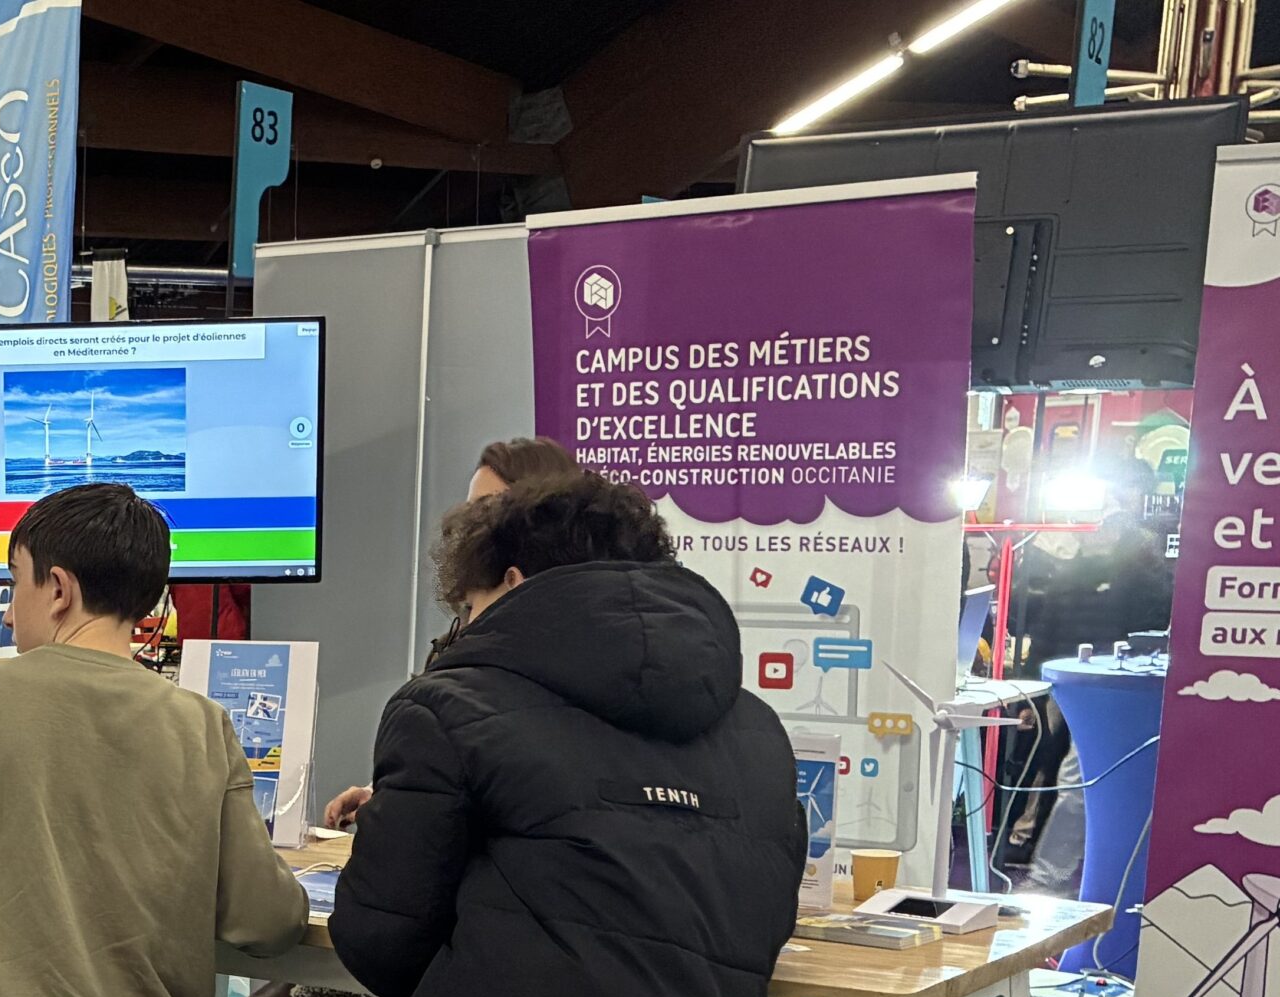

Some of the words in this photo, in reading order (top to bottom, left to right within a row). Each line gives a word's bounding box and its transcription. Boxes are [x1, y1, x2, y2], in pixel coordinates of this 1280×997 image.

[1087, 16, 1105, 66] 82
[251, 106, 279, 146] 83
[36, 336, 68, 346] directs
[69, 336, 99, 345] seront
[101, 334, 126, 344] créés
[128, 335, 150, 345] pour
[152, 333, 161, 342] le
[162, 332, 191, 343] projet
[192, 331, 247, 342] d'éoliennes
[53, 349, 65, 357] en
[67, 346, 129, 357] Méditerranée
[575, 345, 680, 374] CAMPUS
[688, 342, 739, 369] DES
[749, 331, 871, 367] MÉTIERS
[576, 383, 605, 407] ET
[612, 380, 660, 406] DES
[669, 370, 900, 410] QUALIFICATIONS
[1223, 362, 1268, 421] À
[296, 422, 305, 433] 0
[576, 412, 757, 441] D'EXCELLENCE
[576, 447, 643, 466] HABITAT,
[647, 443, 733, 463] ÉNERGIES
[737, 441, 897, 461] RENOUVELABLES
[791, 466, 896, 485] OCCITANIE
[1220, 451, 1280, 486] ve
[1213, 508, 1275, 549] et
[669, 535, 694, 551] UR
[700, 535, 749, 552] TOUS
[755, 535, 792, 552] LES
[799, 532, 890, 553] RÉSEAUX
[1211, 626, 1268, 645] aux
[642, 786, 700, 809] TENTH
